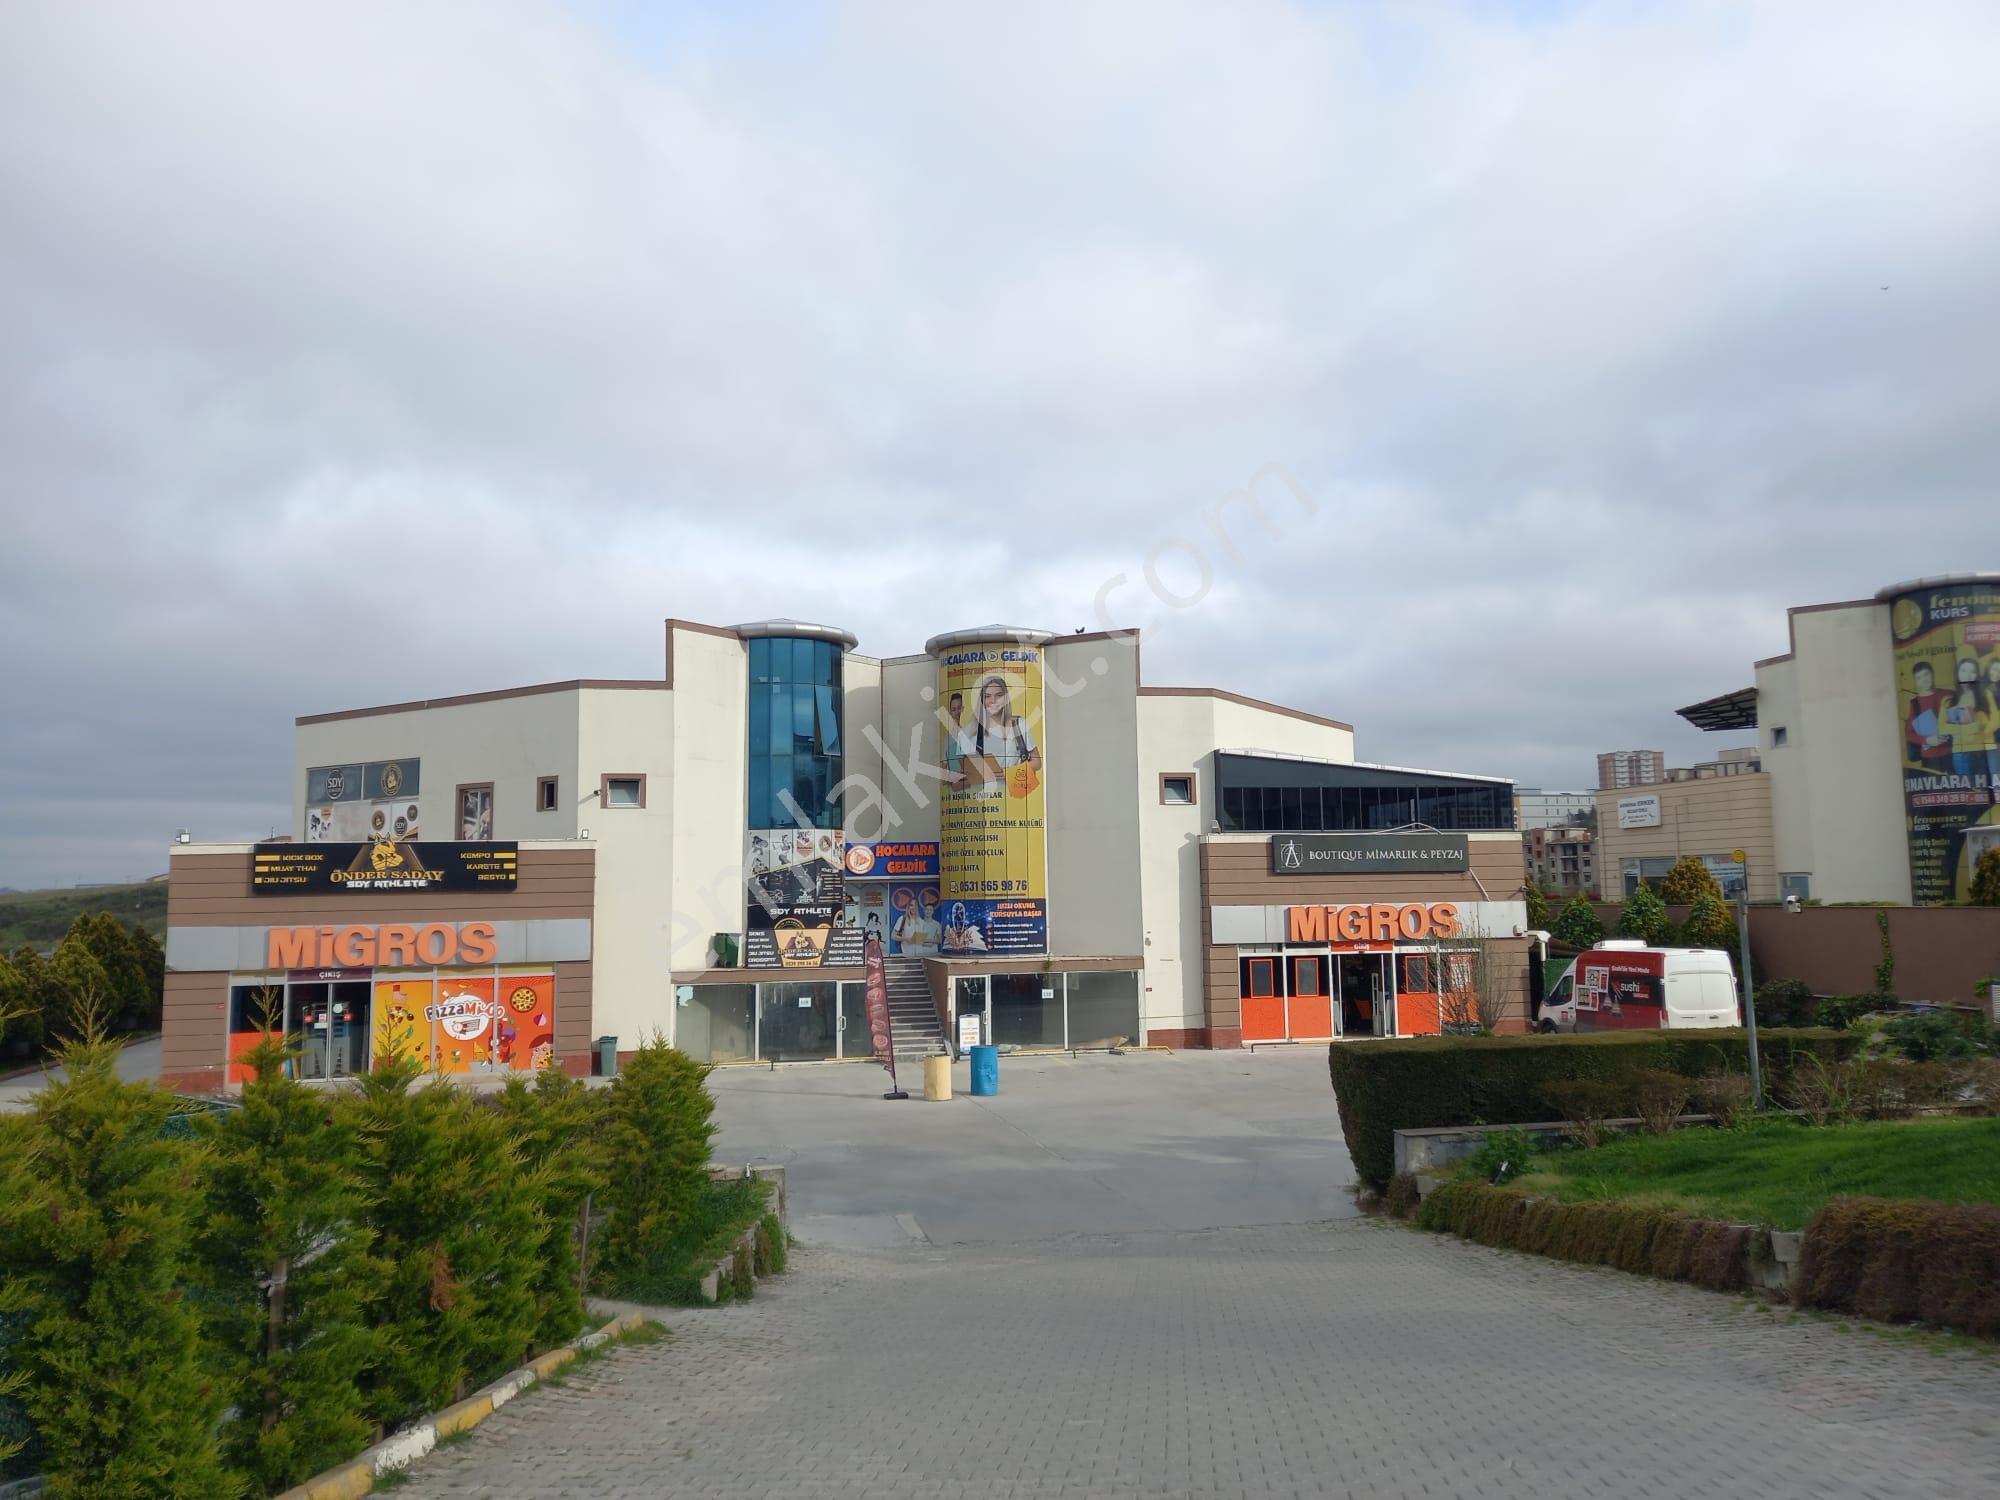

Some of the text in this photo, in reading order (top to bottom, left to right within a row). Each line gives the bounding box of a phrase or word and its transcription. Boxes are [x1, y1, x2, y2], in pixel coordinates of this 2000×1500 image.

[1930, 607, 1968, 619] KURS
[1001, 650, 1038, 662] GELDİK
[327, 778, 344, 788] SDY
[964, 806, 979, 814] ÖZEL
[971, 834, 998, 842] ENGLISH
[876, 845, 935, 857] HOCALARA
[976, 848, 1005, 858] KOÇLUK
[1309, 847, 1463, 861] BOUTIQUE MİMARLIK & PEYZAJ
[887, 859, 928, 873] GELDİK
[330, 869, 445, 883] ÖNDER SADAY
[346, 879, 428, 889] SDY ATHLETE
[960, 880, 1027, 892] 0531 565 98 76
[770, 907, 832, 915] SDY ATHLETE
[1288, 903, 1460, 942] MiGROS
[268, 922, 498, 969] MiGROS
[1620, 981, 1640, 993] sushi
